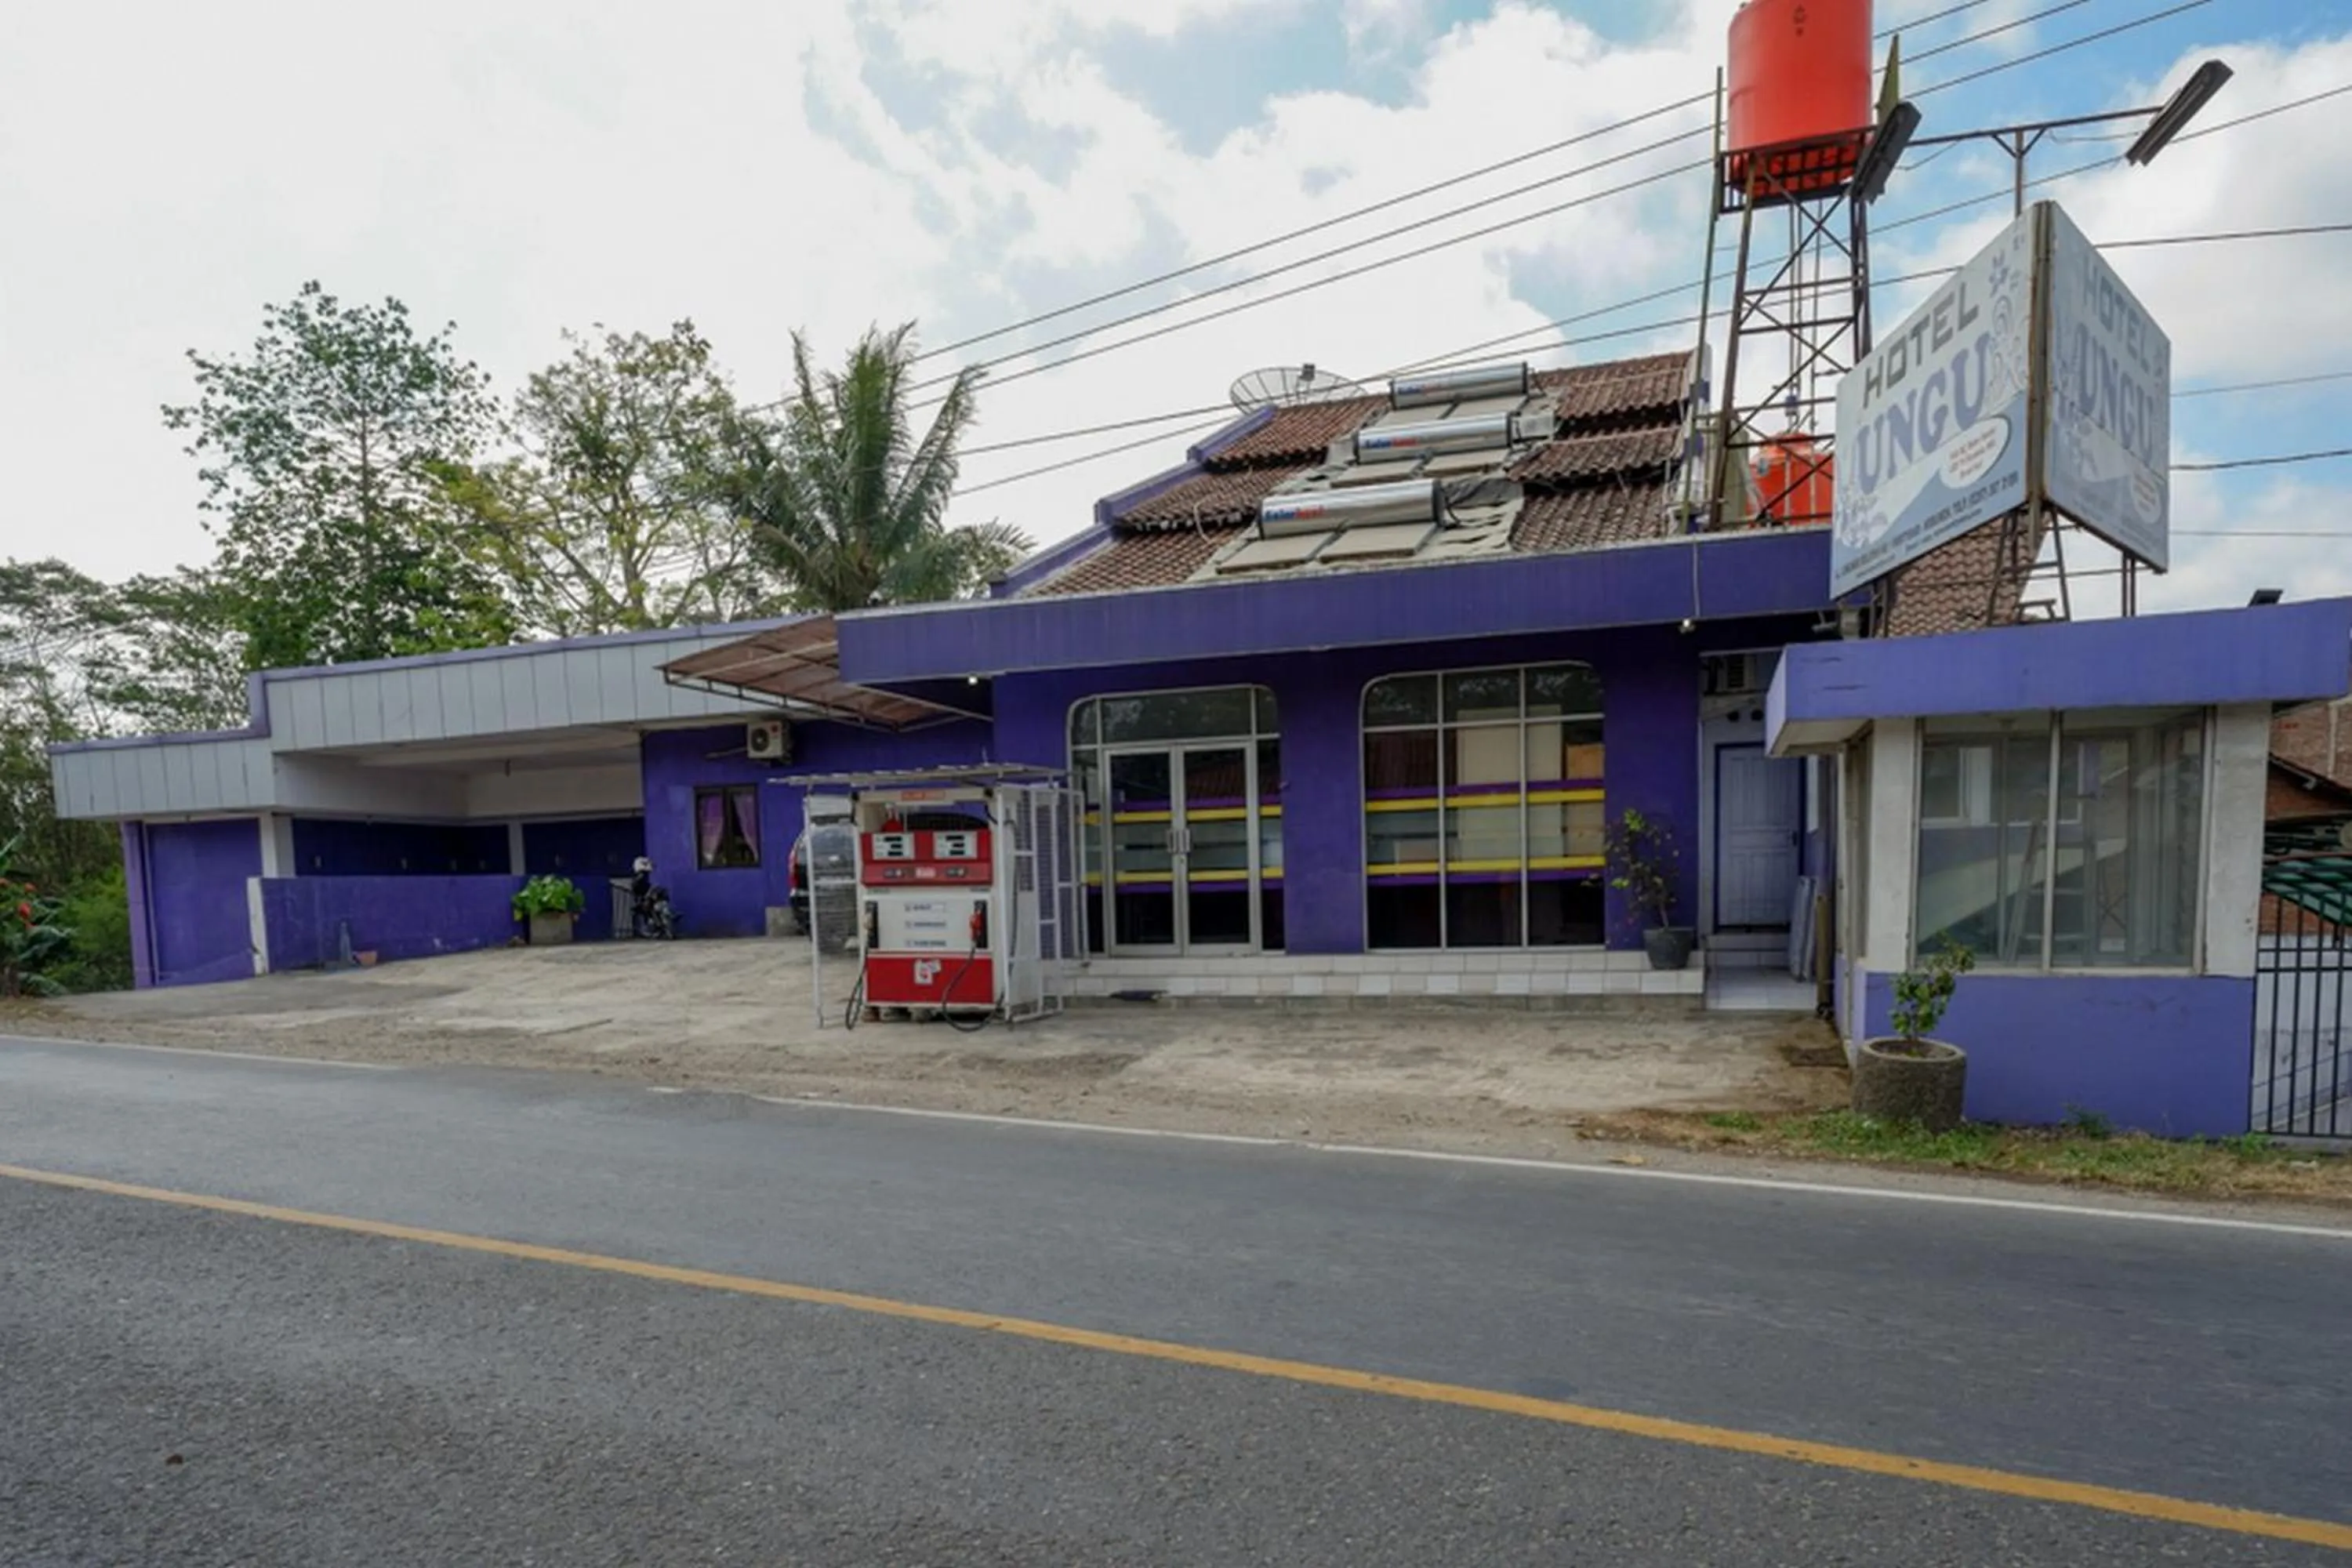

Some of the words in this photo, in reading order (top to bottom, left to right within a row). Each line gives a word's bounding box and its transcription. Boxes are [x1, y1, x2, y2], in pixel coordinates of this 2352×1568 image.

[1863, 281, 1980, 409] HOTEL
[2082, 256, 2151, 374] HOTEL
[1857, 330, 1991, 495] UNGU
[2074, 323, 2154, 464] UNGU
